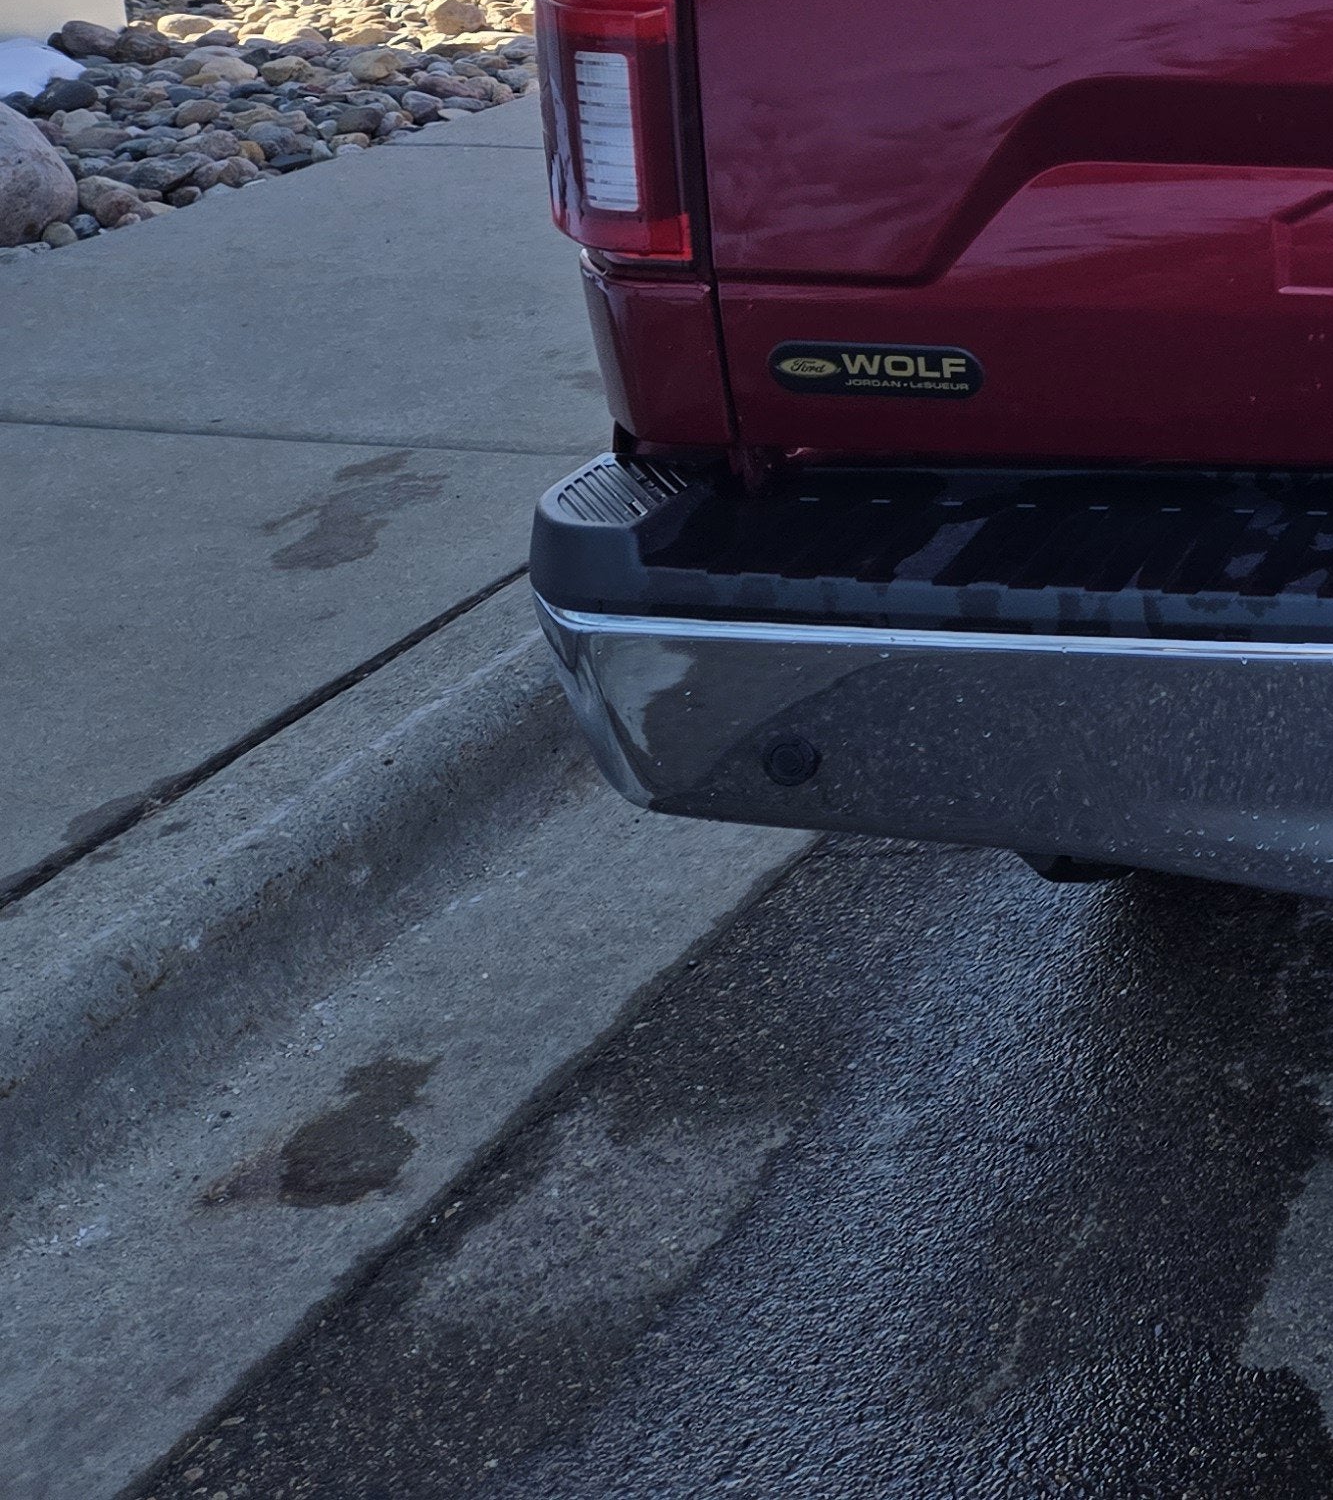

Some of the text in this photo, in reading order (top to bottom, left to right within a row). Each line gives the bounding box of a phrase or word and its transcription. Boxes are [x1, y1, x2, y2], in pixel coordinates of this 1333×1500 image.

[790, 353, 967, 379] Ford WOLF
[844, 378, 901, 389] JORDAN
